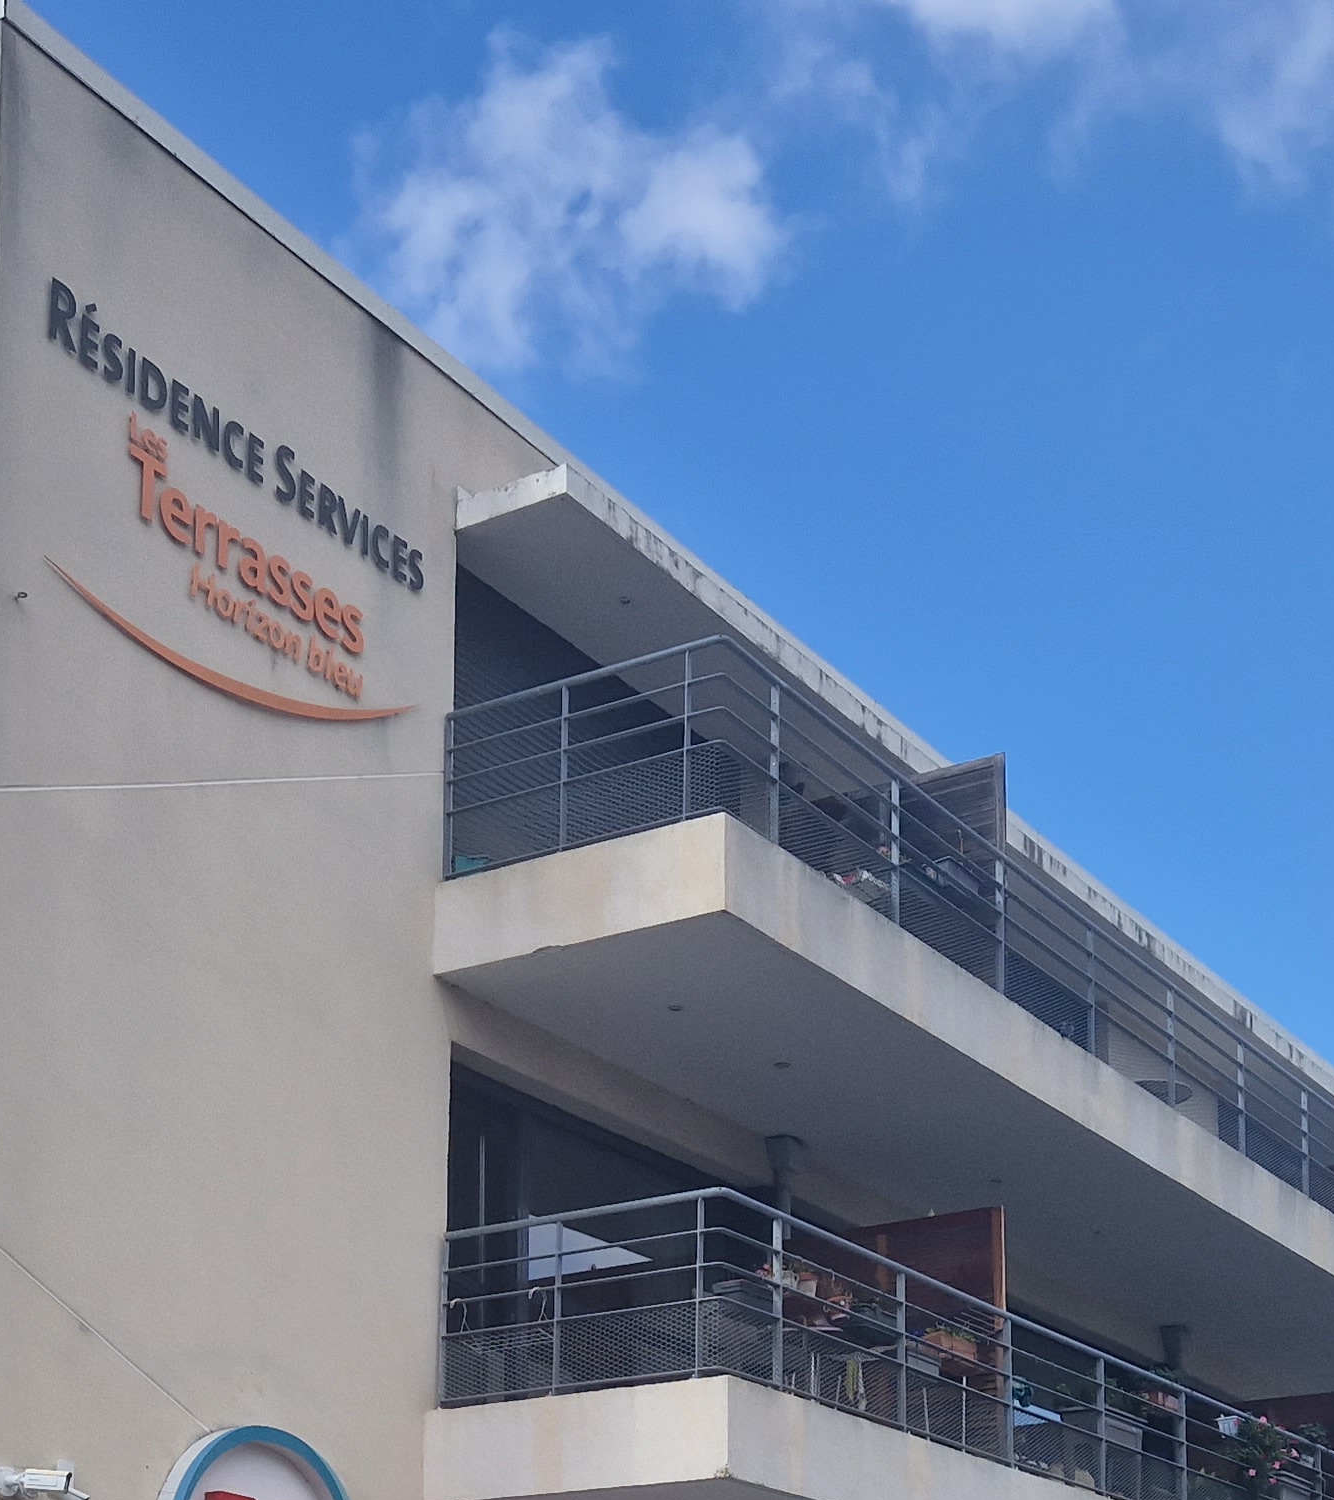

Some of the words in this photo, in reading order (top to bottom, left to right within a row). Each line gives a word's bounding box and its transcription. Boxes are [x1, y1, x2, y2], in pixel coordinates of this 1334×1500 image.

[48, 277, 265, 485] RÉSIDENCE
[275, 444, 424, 591] SERVICES
[128, 410, 168, 463] Les
[129, 443, 364, 655] Terrasses
[189, 562, 302, 662] Horizon
[307, 633, 362, 700] bleu
